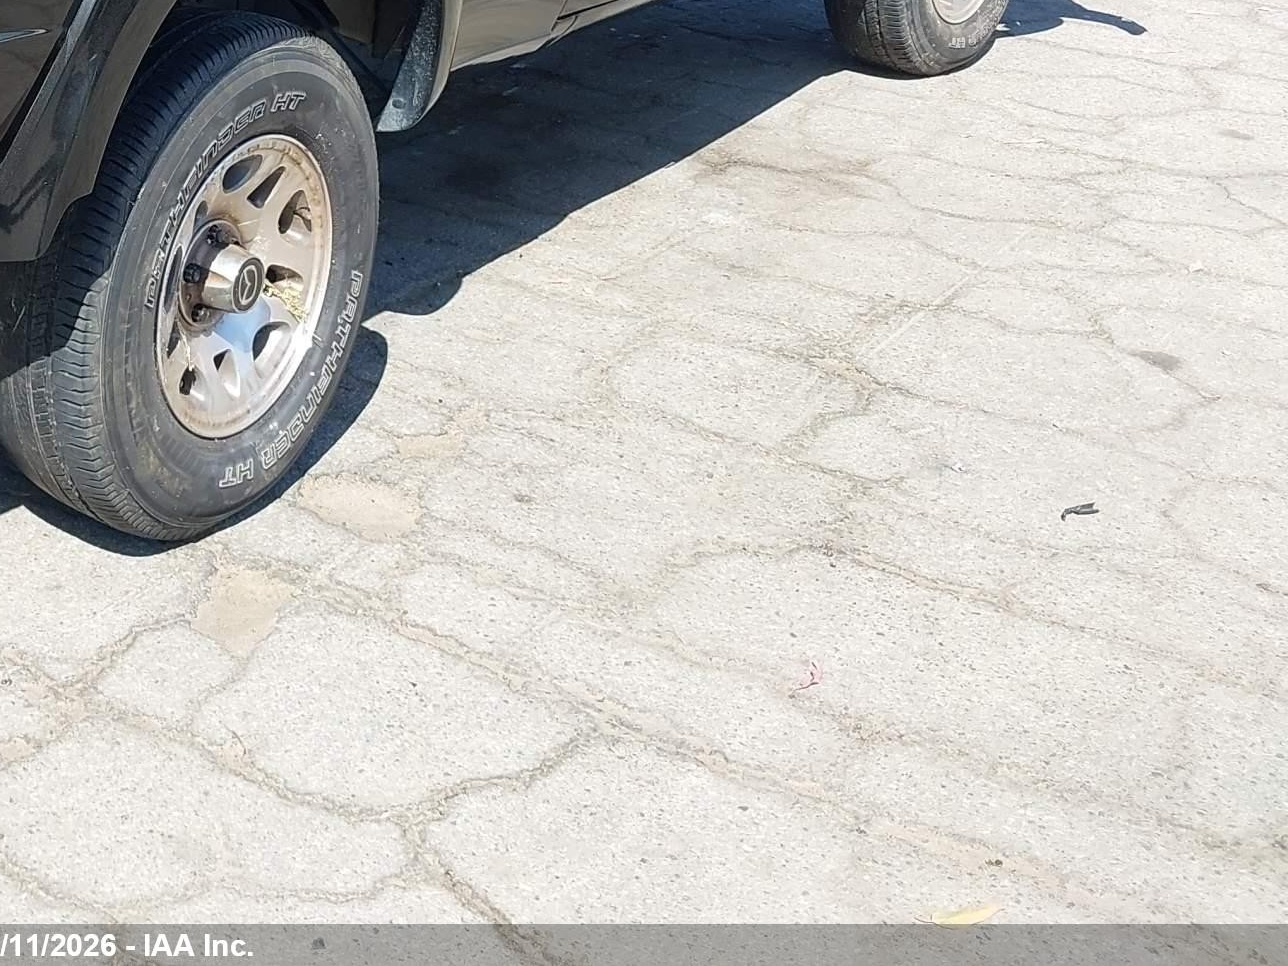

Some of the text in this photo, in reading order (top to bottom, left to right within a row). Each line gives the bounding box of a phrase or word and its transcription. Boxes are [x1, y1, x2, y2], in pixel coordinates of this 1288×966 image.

[145, 91, 307, 309] PATHFINDER HT
[219, 270, 364, 488] PATHFINDER HT
